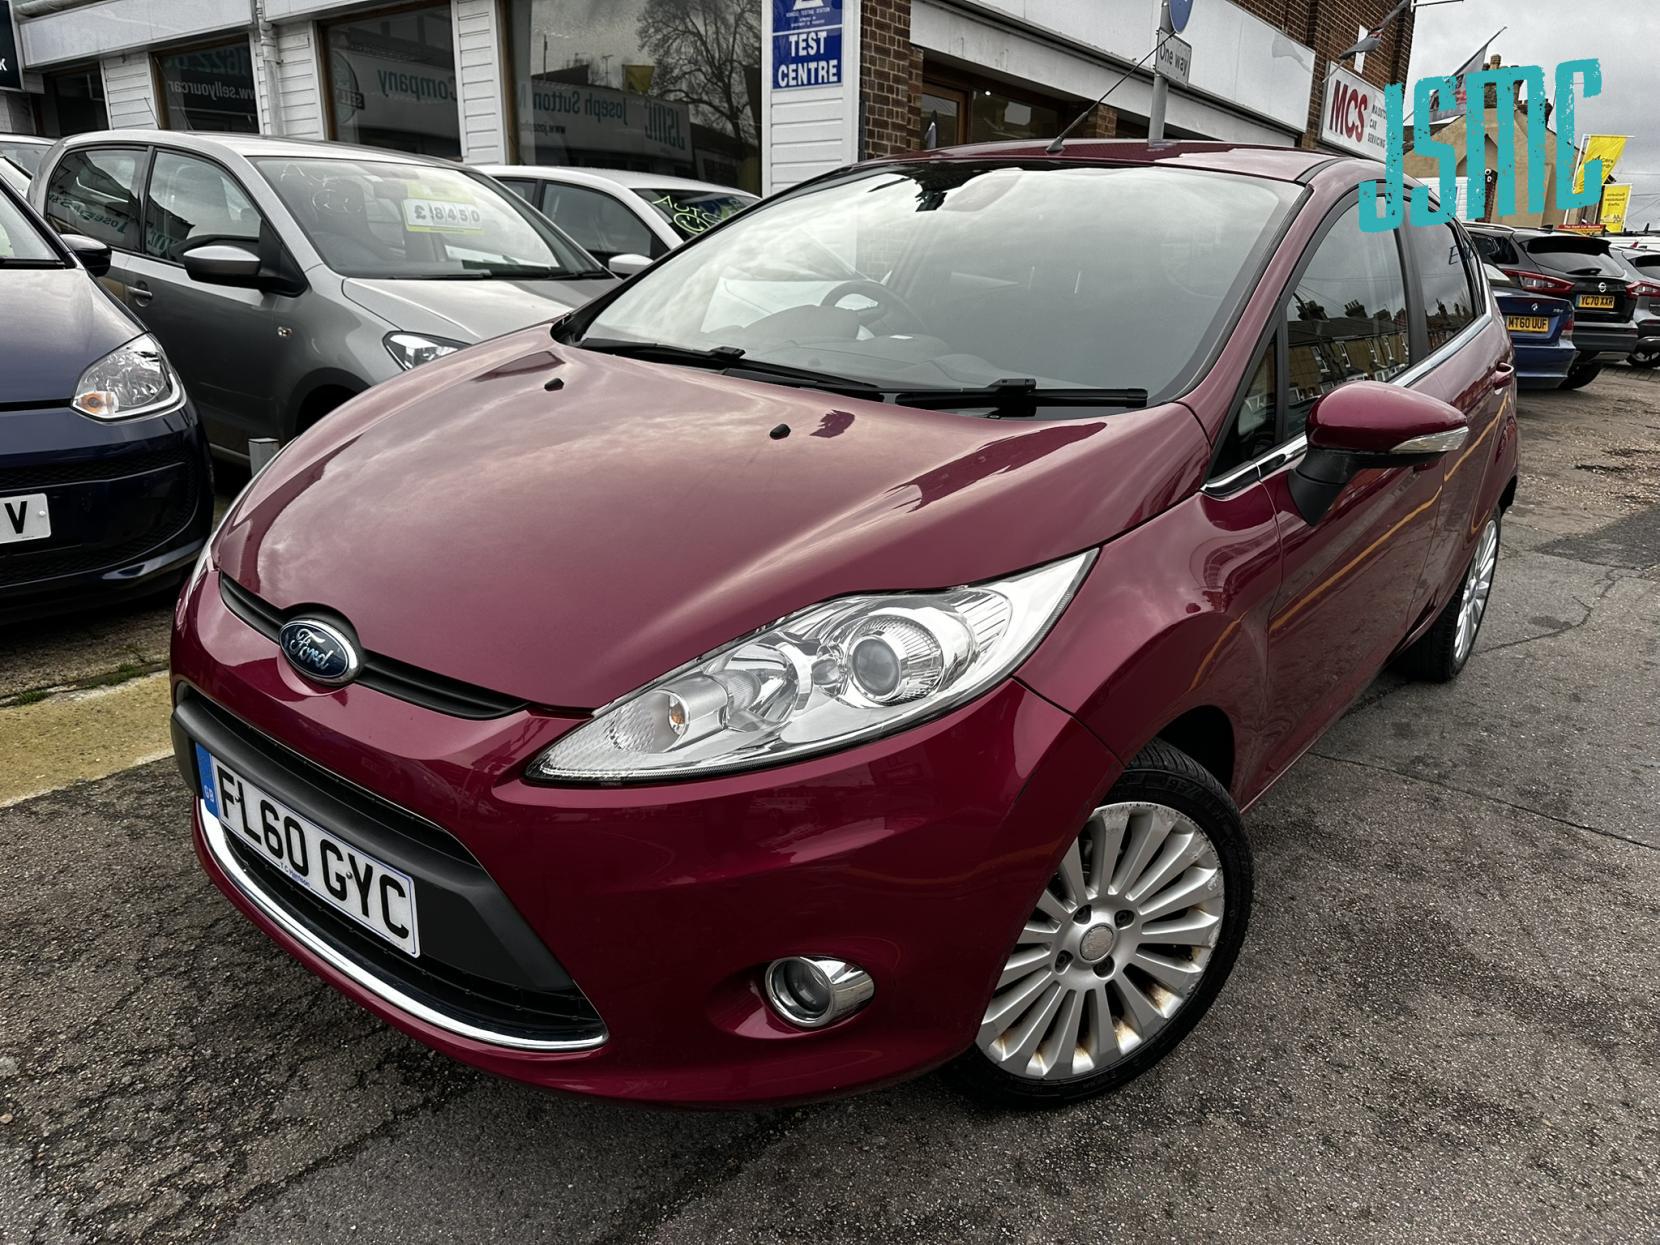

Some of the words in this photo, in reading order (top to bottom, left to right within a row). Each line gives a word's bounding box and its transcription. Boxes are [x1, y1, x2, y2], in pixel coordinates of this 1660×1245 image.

[789, 31, 827, 57] TEST
[1160, 43, 1173, 65] One
[1175, 54, 1189, 76] way
[778, 59, 838, 87] CENTRE
[1329, 79, 1367, 143] MCS
[4, 500, 28, 534] V
[289, 628, 334, 670] Ford
[217, 765, 309, 877] FL60
[320, 838, 409, 939] GYC
